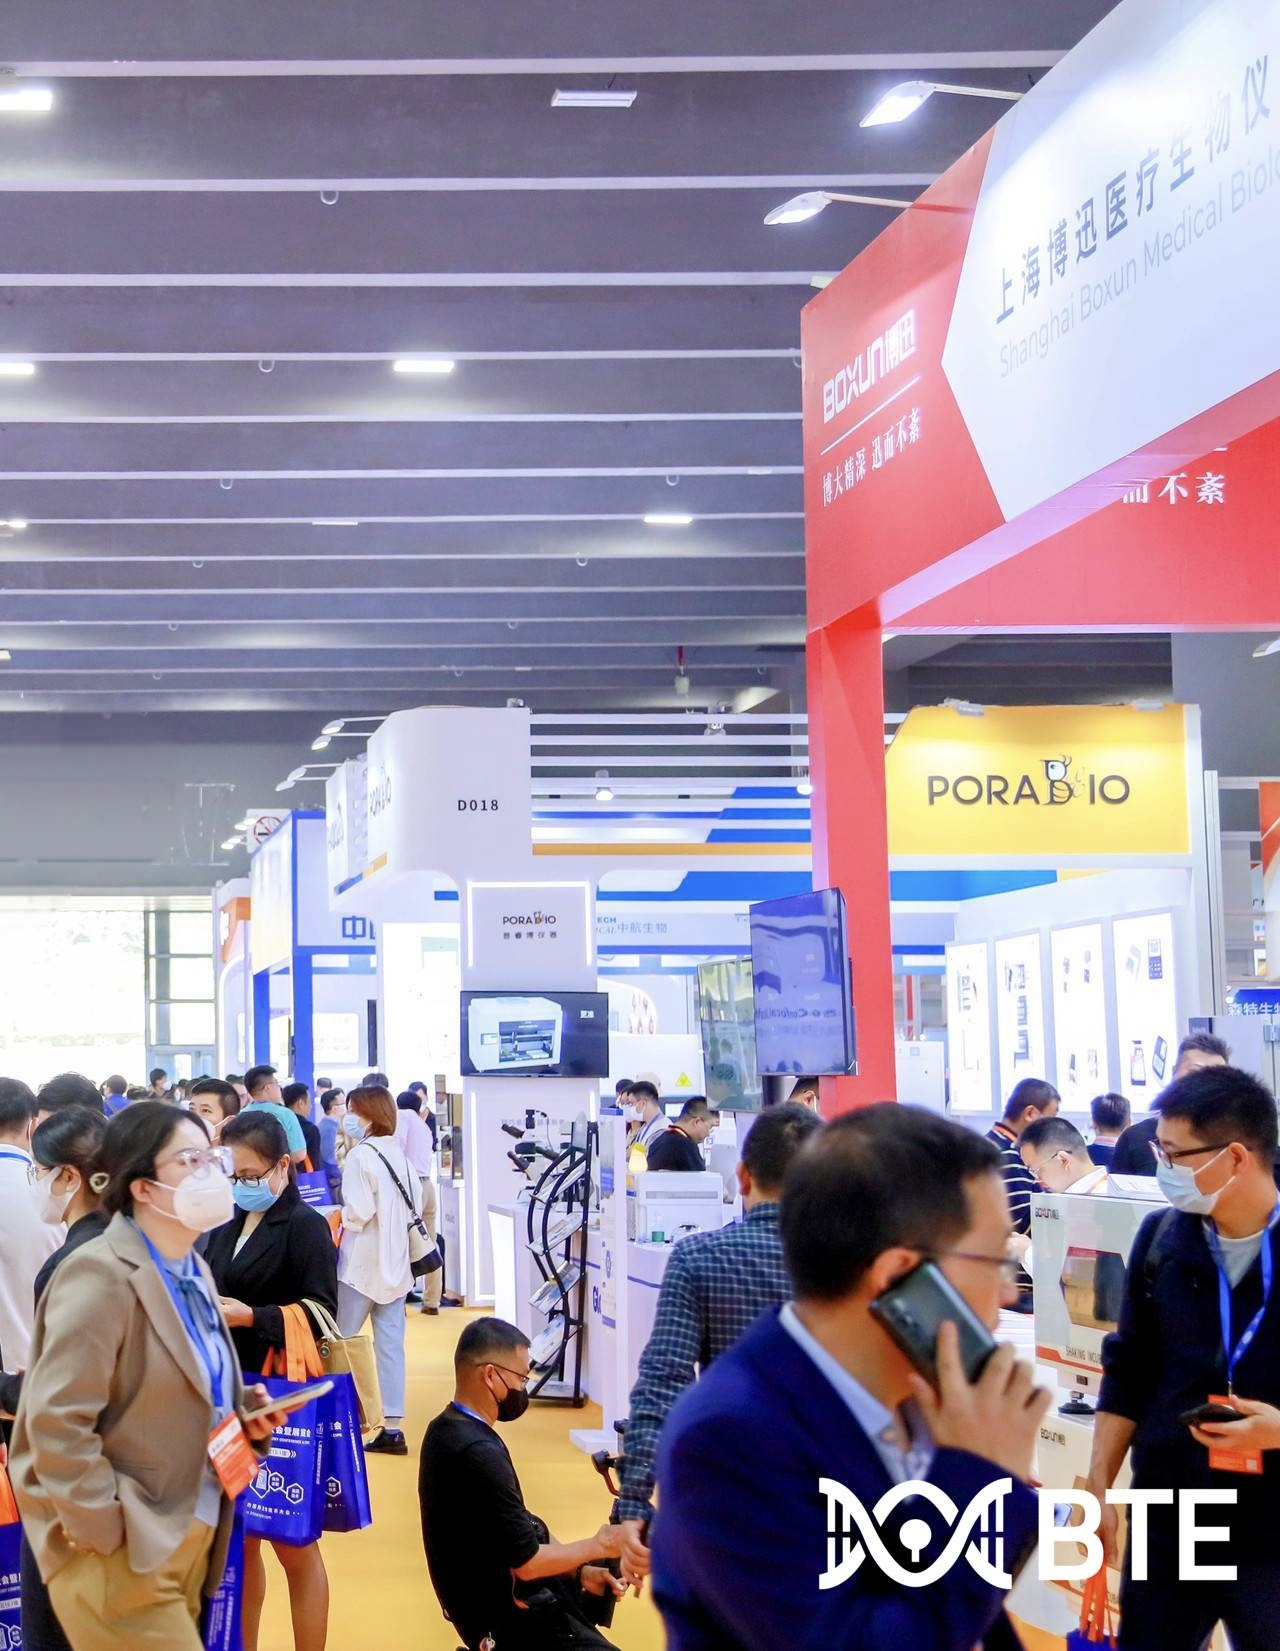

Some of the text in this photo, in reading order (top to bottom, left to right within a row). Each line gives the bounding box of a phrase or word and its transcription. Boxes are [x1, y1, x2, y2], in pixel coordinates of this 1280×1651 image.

[995, 55, 1272, 325] 上海博迅医疗生物仪
[1000, 302, 1076, 379] Shanghai
[1081, 258, 1137, 321] Boxun
[1144, 181, 1223, 277] Medical
[822, 407, 921, 508] 博大精深 迅而不紊
[457, 799, 500, 812] D018
[342, 915, 376, 940] 中
[596, 916, 617, 924] ECH
